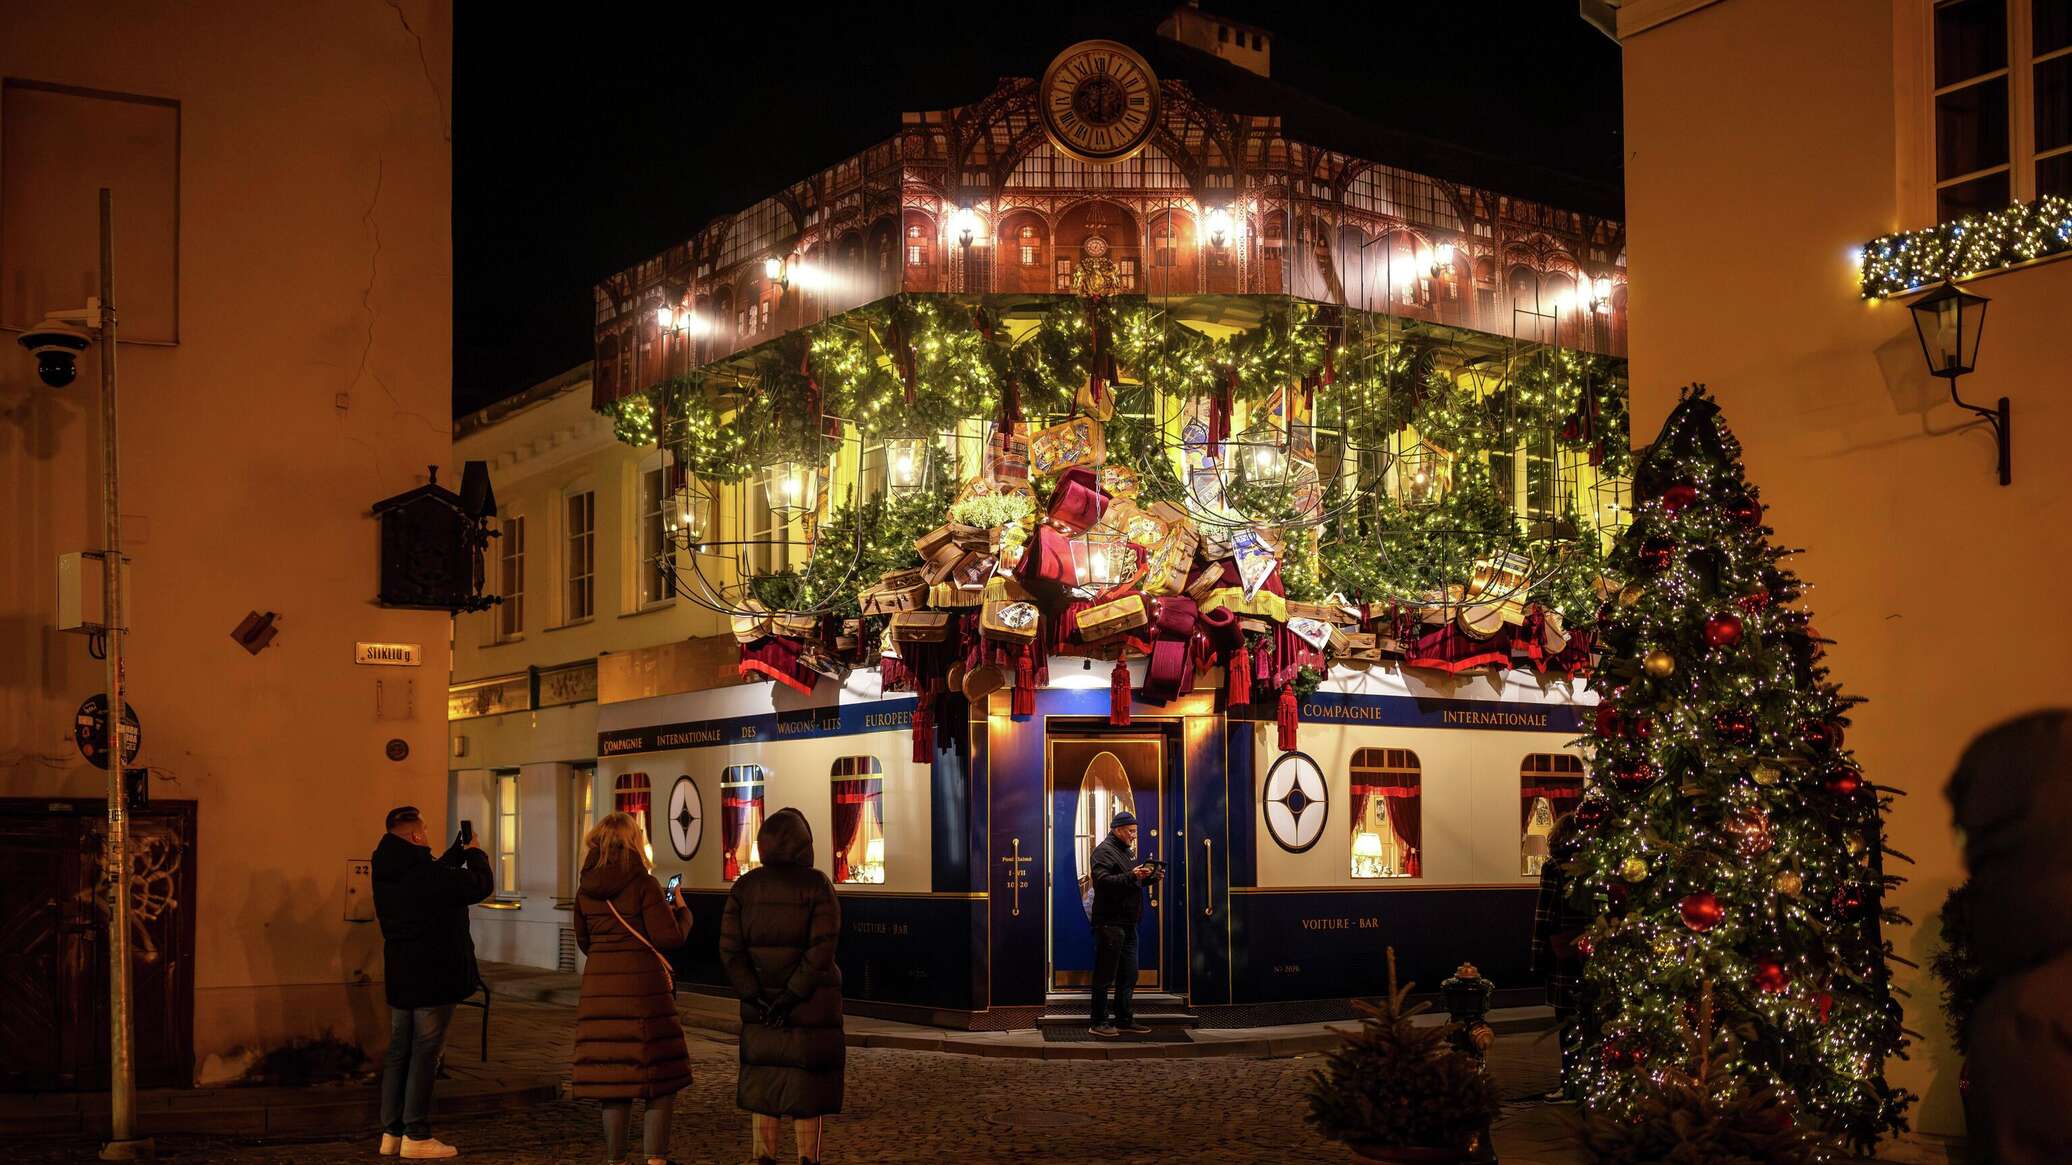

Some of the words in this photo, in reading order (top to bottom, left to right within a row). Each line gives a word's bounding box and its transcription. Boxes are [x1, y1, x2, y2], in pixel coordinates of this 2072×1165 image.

[1303, 704, 1382, 720] COMPAGNIE
[1443, 710, 1548, 727] INTERNATIONALE
[603, 738, 642, 754] COMPAGNIE
[657, 729, 721, 746] INTERNATIONALE
[741, 726, 757, 738] DES
[777, 719, 816, 735] WAGONS
[823, 717, 842, 732] LITS
[355, 865, 369, 874] 22
[1302, 918, 1349, 930] VOITURE
[1359, 917, 1380, 929] BAR
